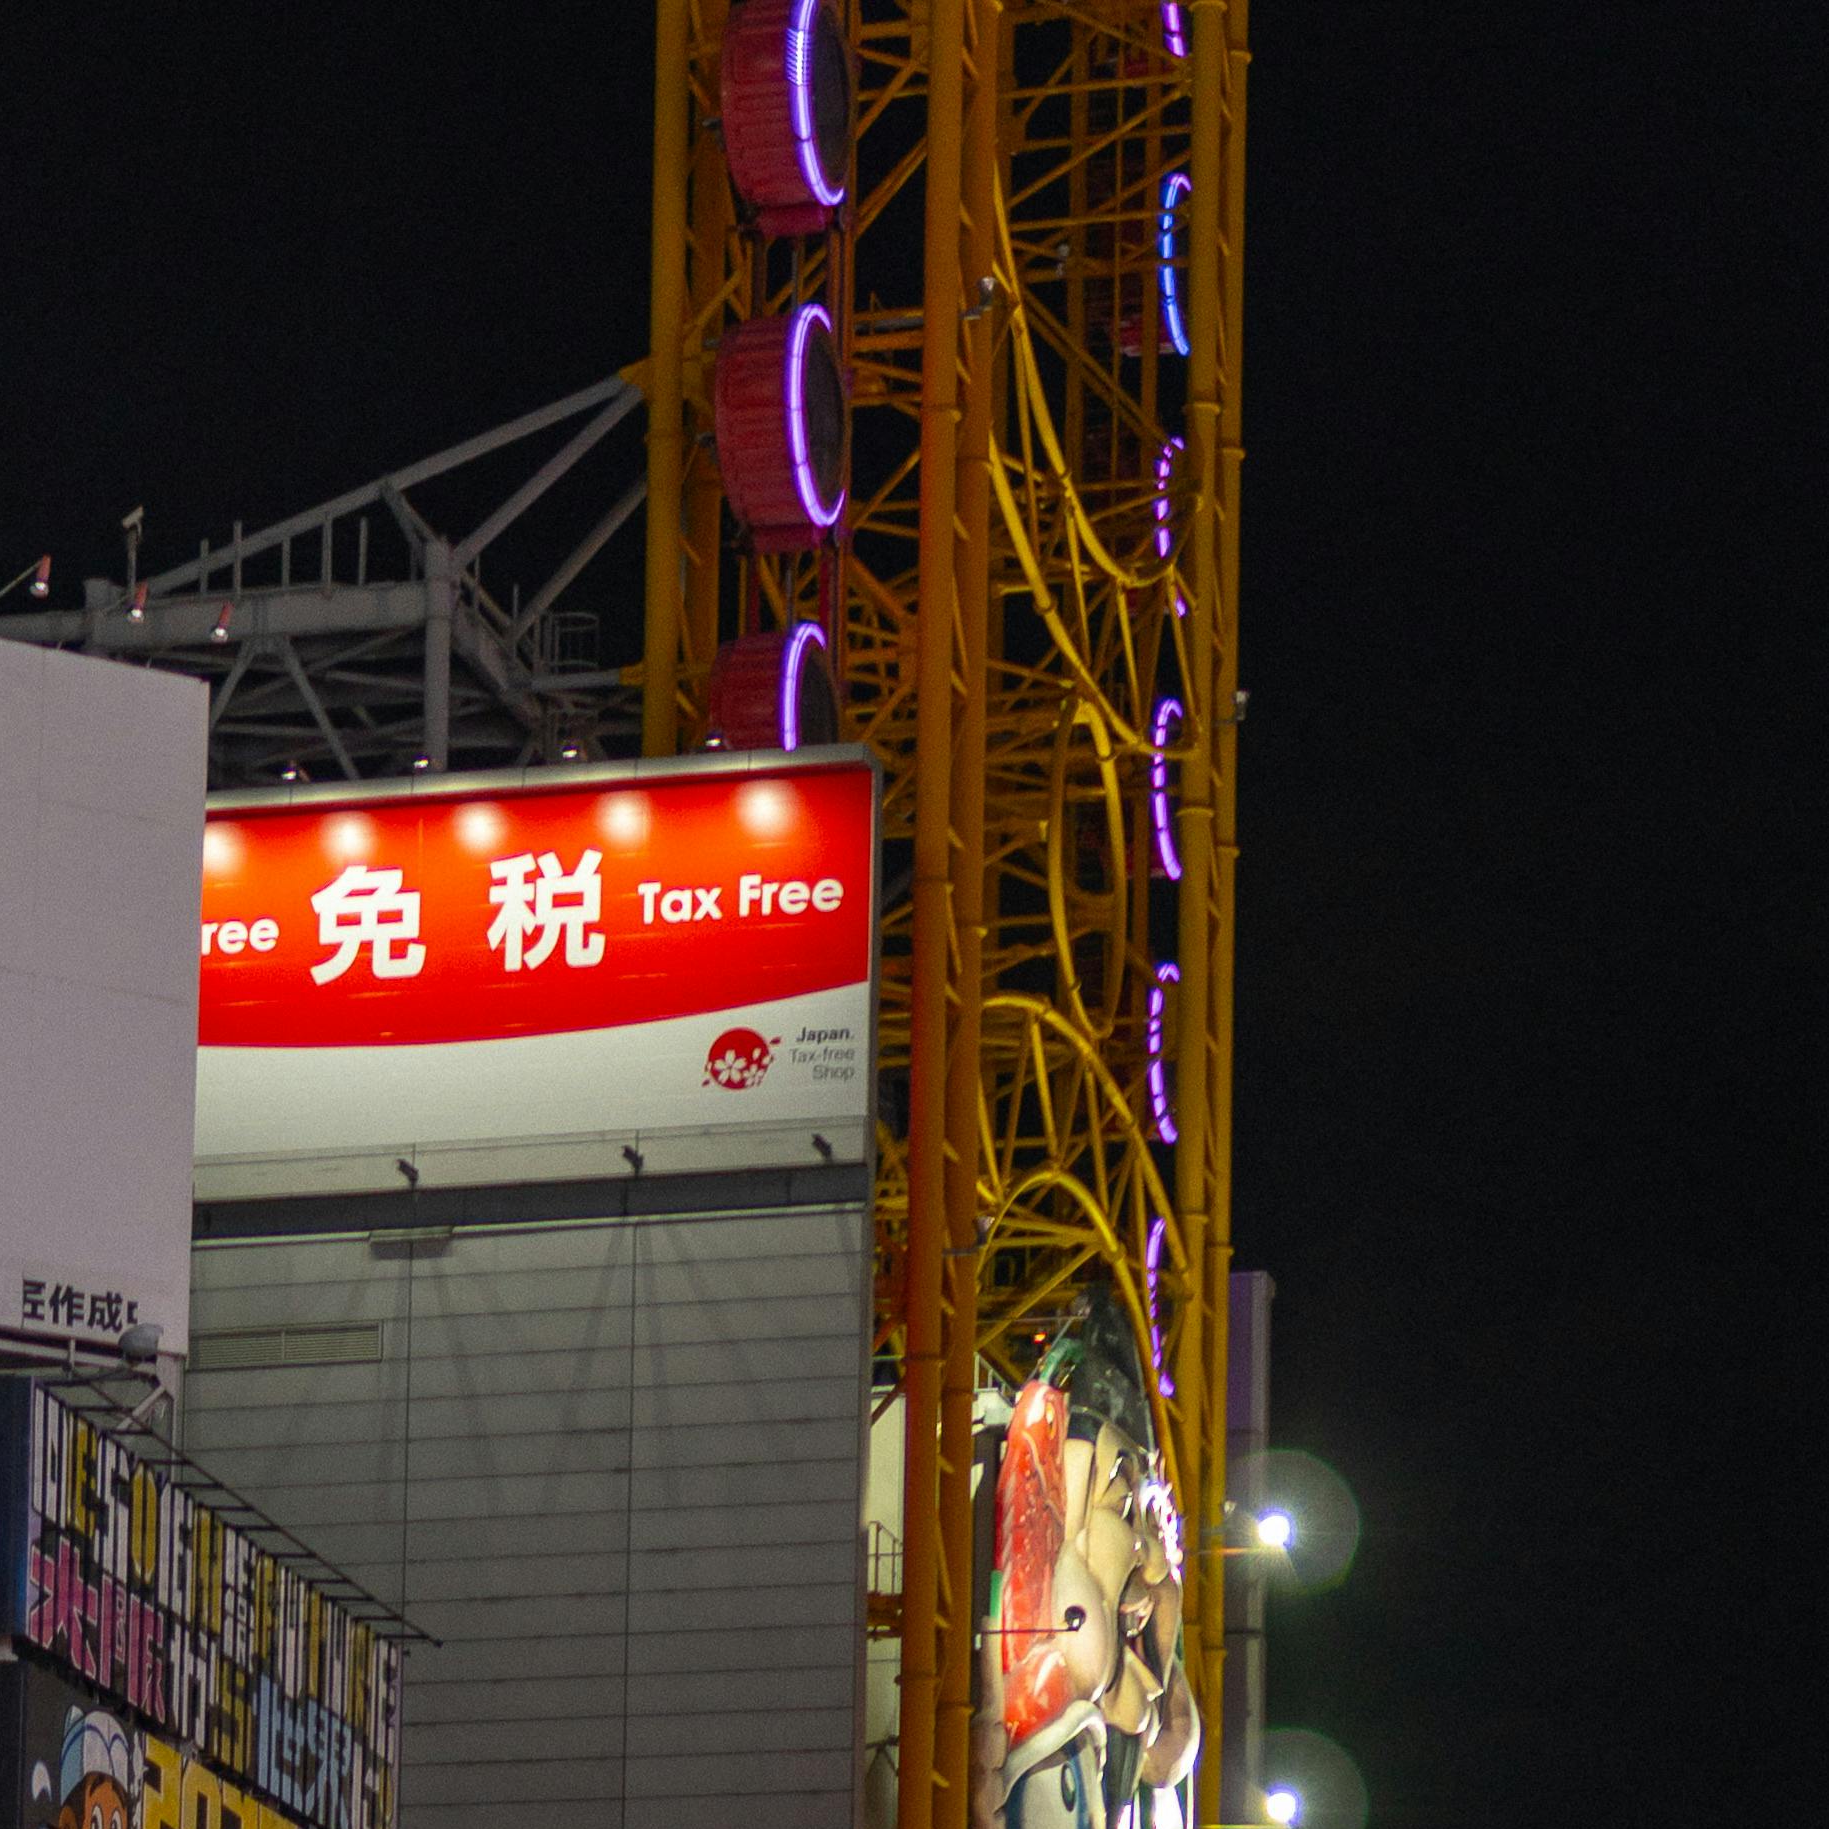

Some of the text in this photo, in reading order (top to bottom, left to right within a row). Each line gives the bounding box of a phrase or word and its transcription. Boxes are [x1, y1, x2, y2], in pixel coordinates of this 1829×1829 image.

[201, 849, 843, 984] ree 免税 Tax Free
[789, 1045, 855, 1065] Tax-free
[813, 1062, 855, 1082] Shop
